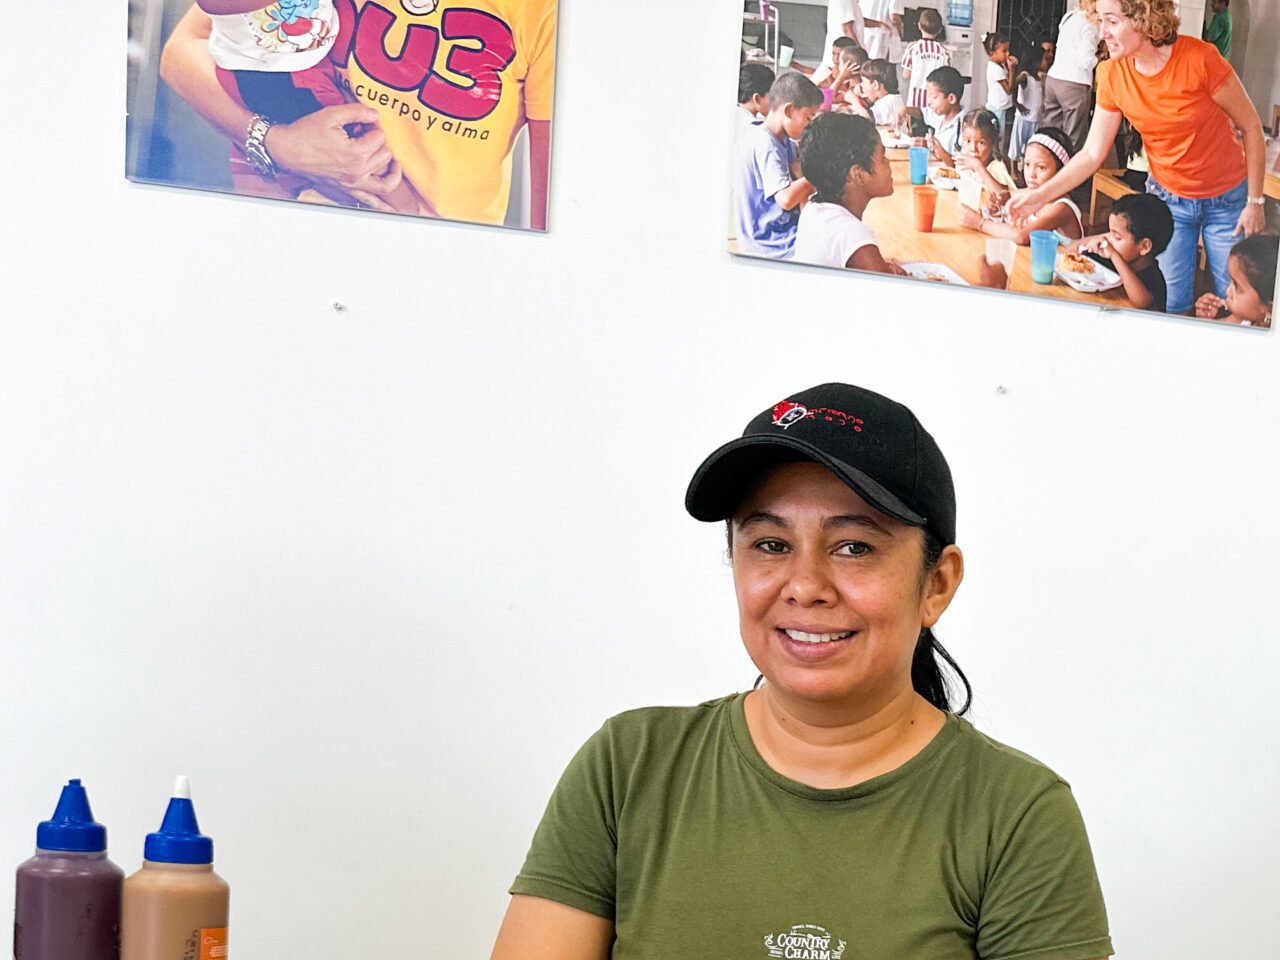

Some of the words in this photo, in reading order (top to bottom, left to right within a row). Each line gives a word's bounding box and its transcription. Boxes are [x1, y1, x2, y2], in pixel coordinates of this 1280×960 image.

[355, 84, 421, 121] cuerpo
[425, 114, 438, 130] y
[441, 121, 490, 140] alma
